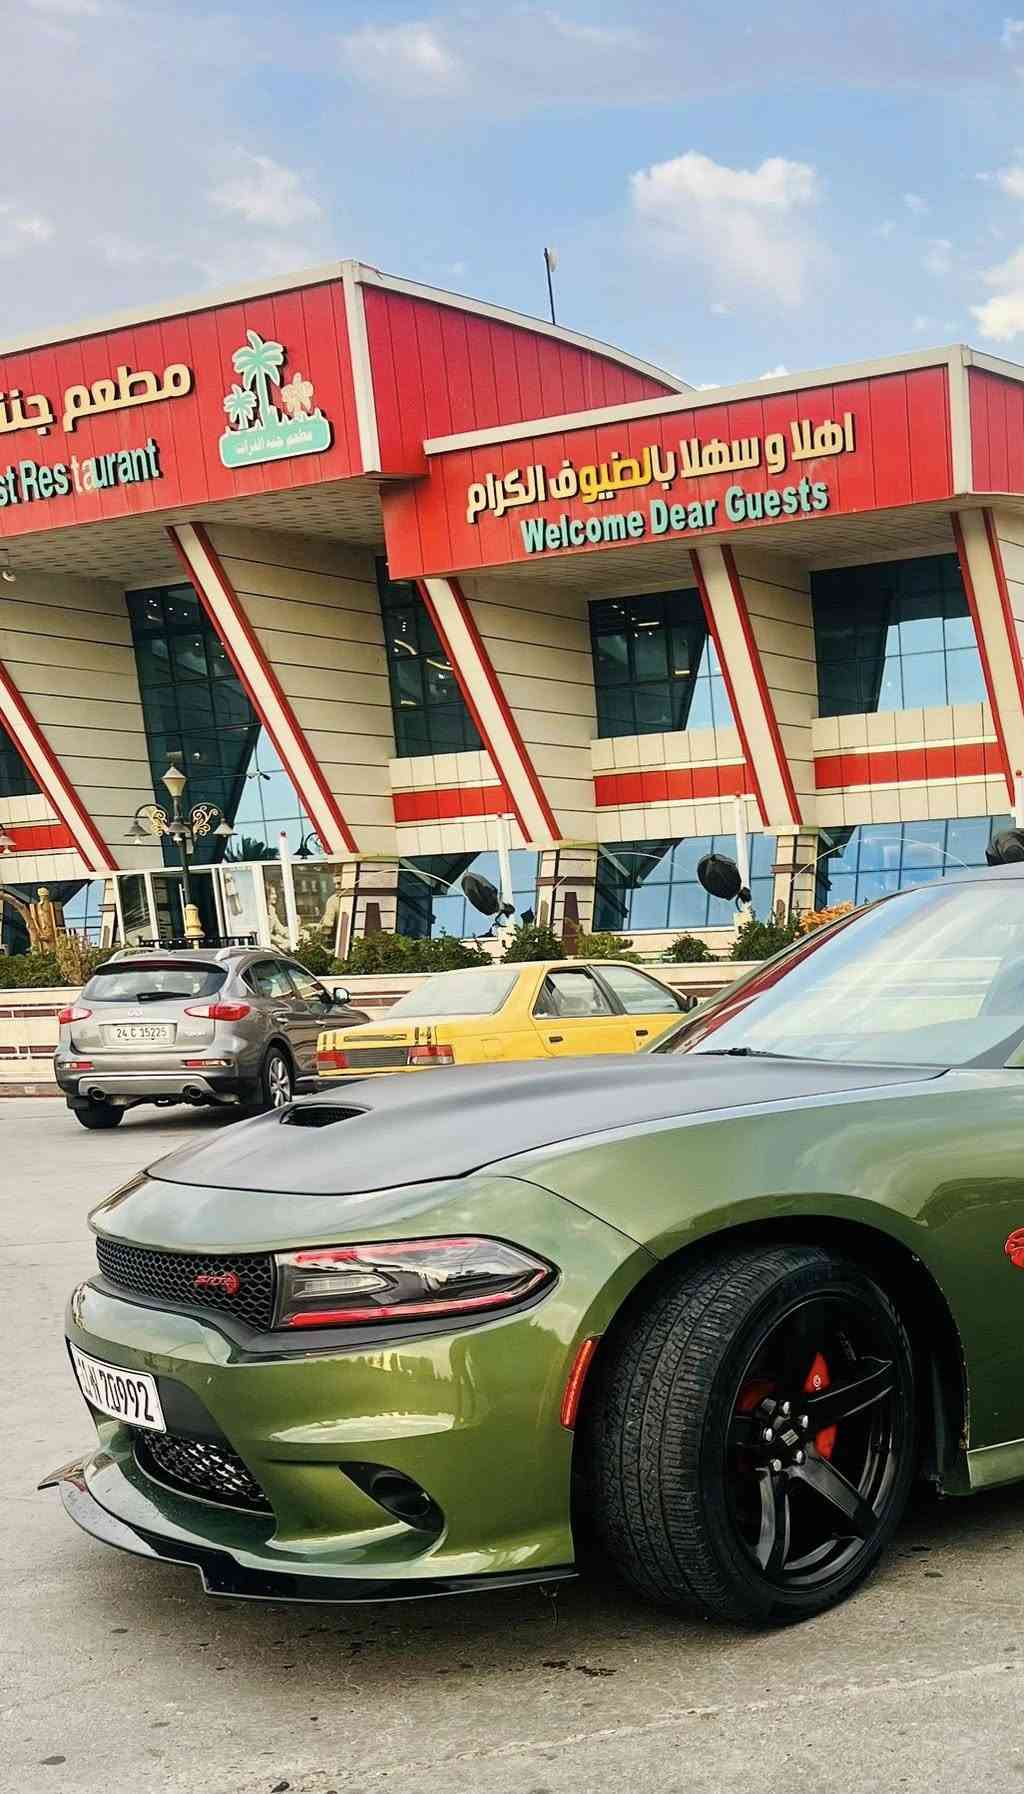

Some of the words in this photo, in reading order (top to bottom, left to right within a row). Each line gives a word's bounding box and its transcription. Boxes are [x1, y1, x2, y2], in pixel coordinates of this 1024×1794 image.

[63, 363, 192, 433] مطعم
[679, 436, 760, 479] سهلا
[765, 432, 786, 475] و
[790, 412, 855, 461] اهلا
[467, 463, 547, 524] الكرام
[549, 444, 677, 505] بالضيوف
[519, 510, 645, 553] Welcome
[650, 499, 717, 535] Dear
[725, 475, 829, 523] Guests
